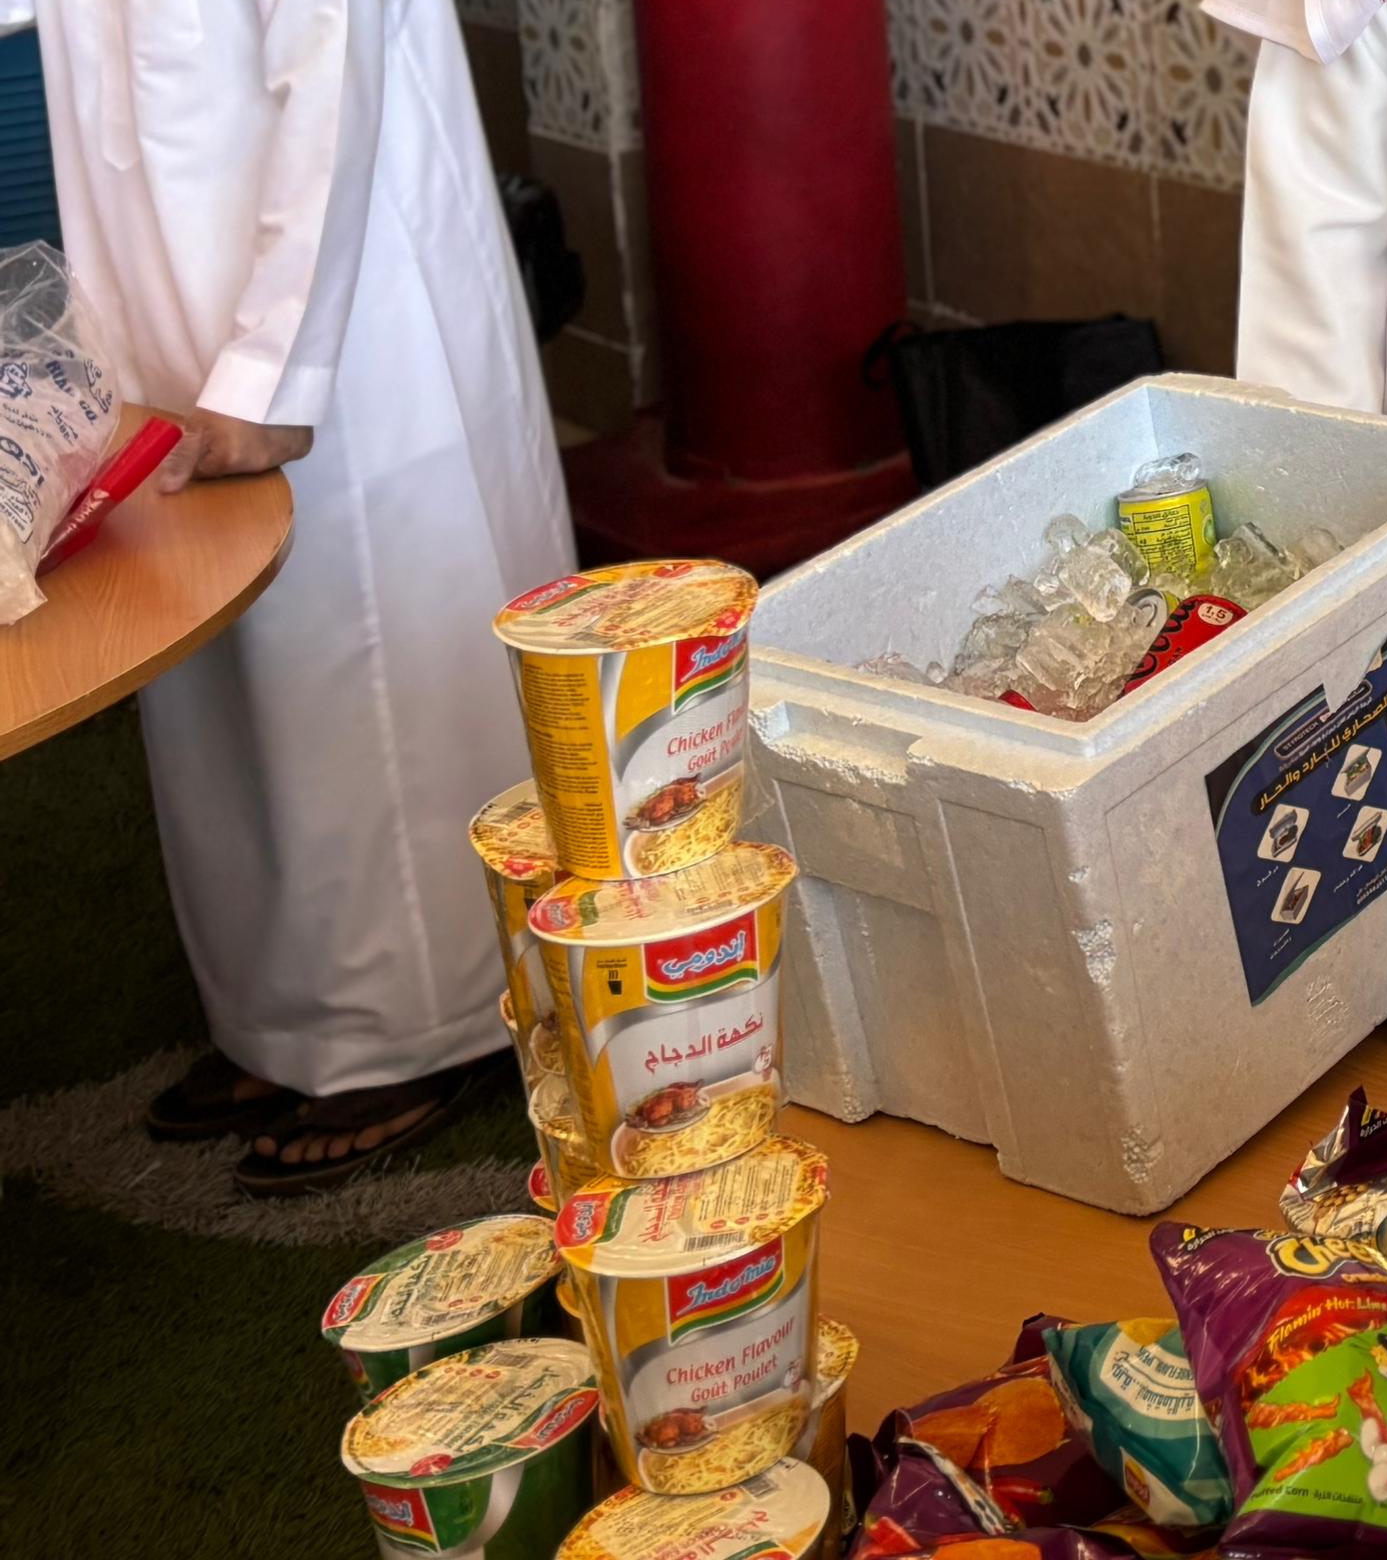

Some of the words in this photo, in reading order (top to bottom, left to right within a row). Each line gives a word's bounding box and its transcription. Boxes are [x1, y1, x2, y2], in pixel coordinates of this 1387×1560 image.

[1204, 605, 1227, 620] 1.5
[667, 721, 723, 756] Chicken
[661, 930, 747, 980] إندومي
[716, 1012, 766, 1051] نكهة
[644, 1033, 713, 1076] الدجاج
[676, 1256, 777, 1317] Indomie
[1357, 1297, 1387, 1312] Lime
[666, 1356, 736, 1385] Chicken
[742, 1316, 796, 1365] Flavour
[691, 1380, 728, 1403] Goût
[733, 1354, 778, 1390] Poulet
